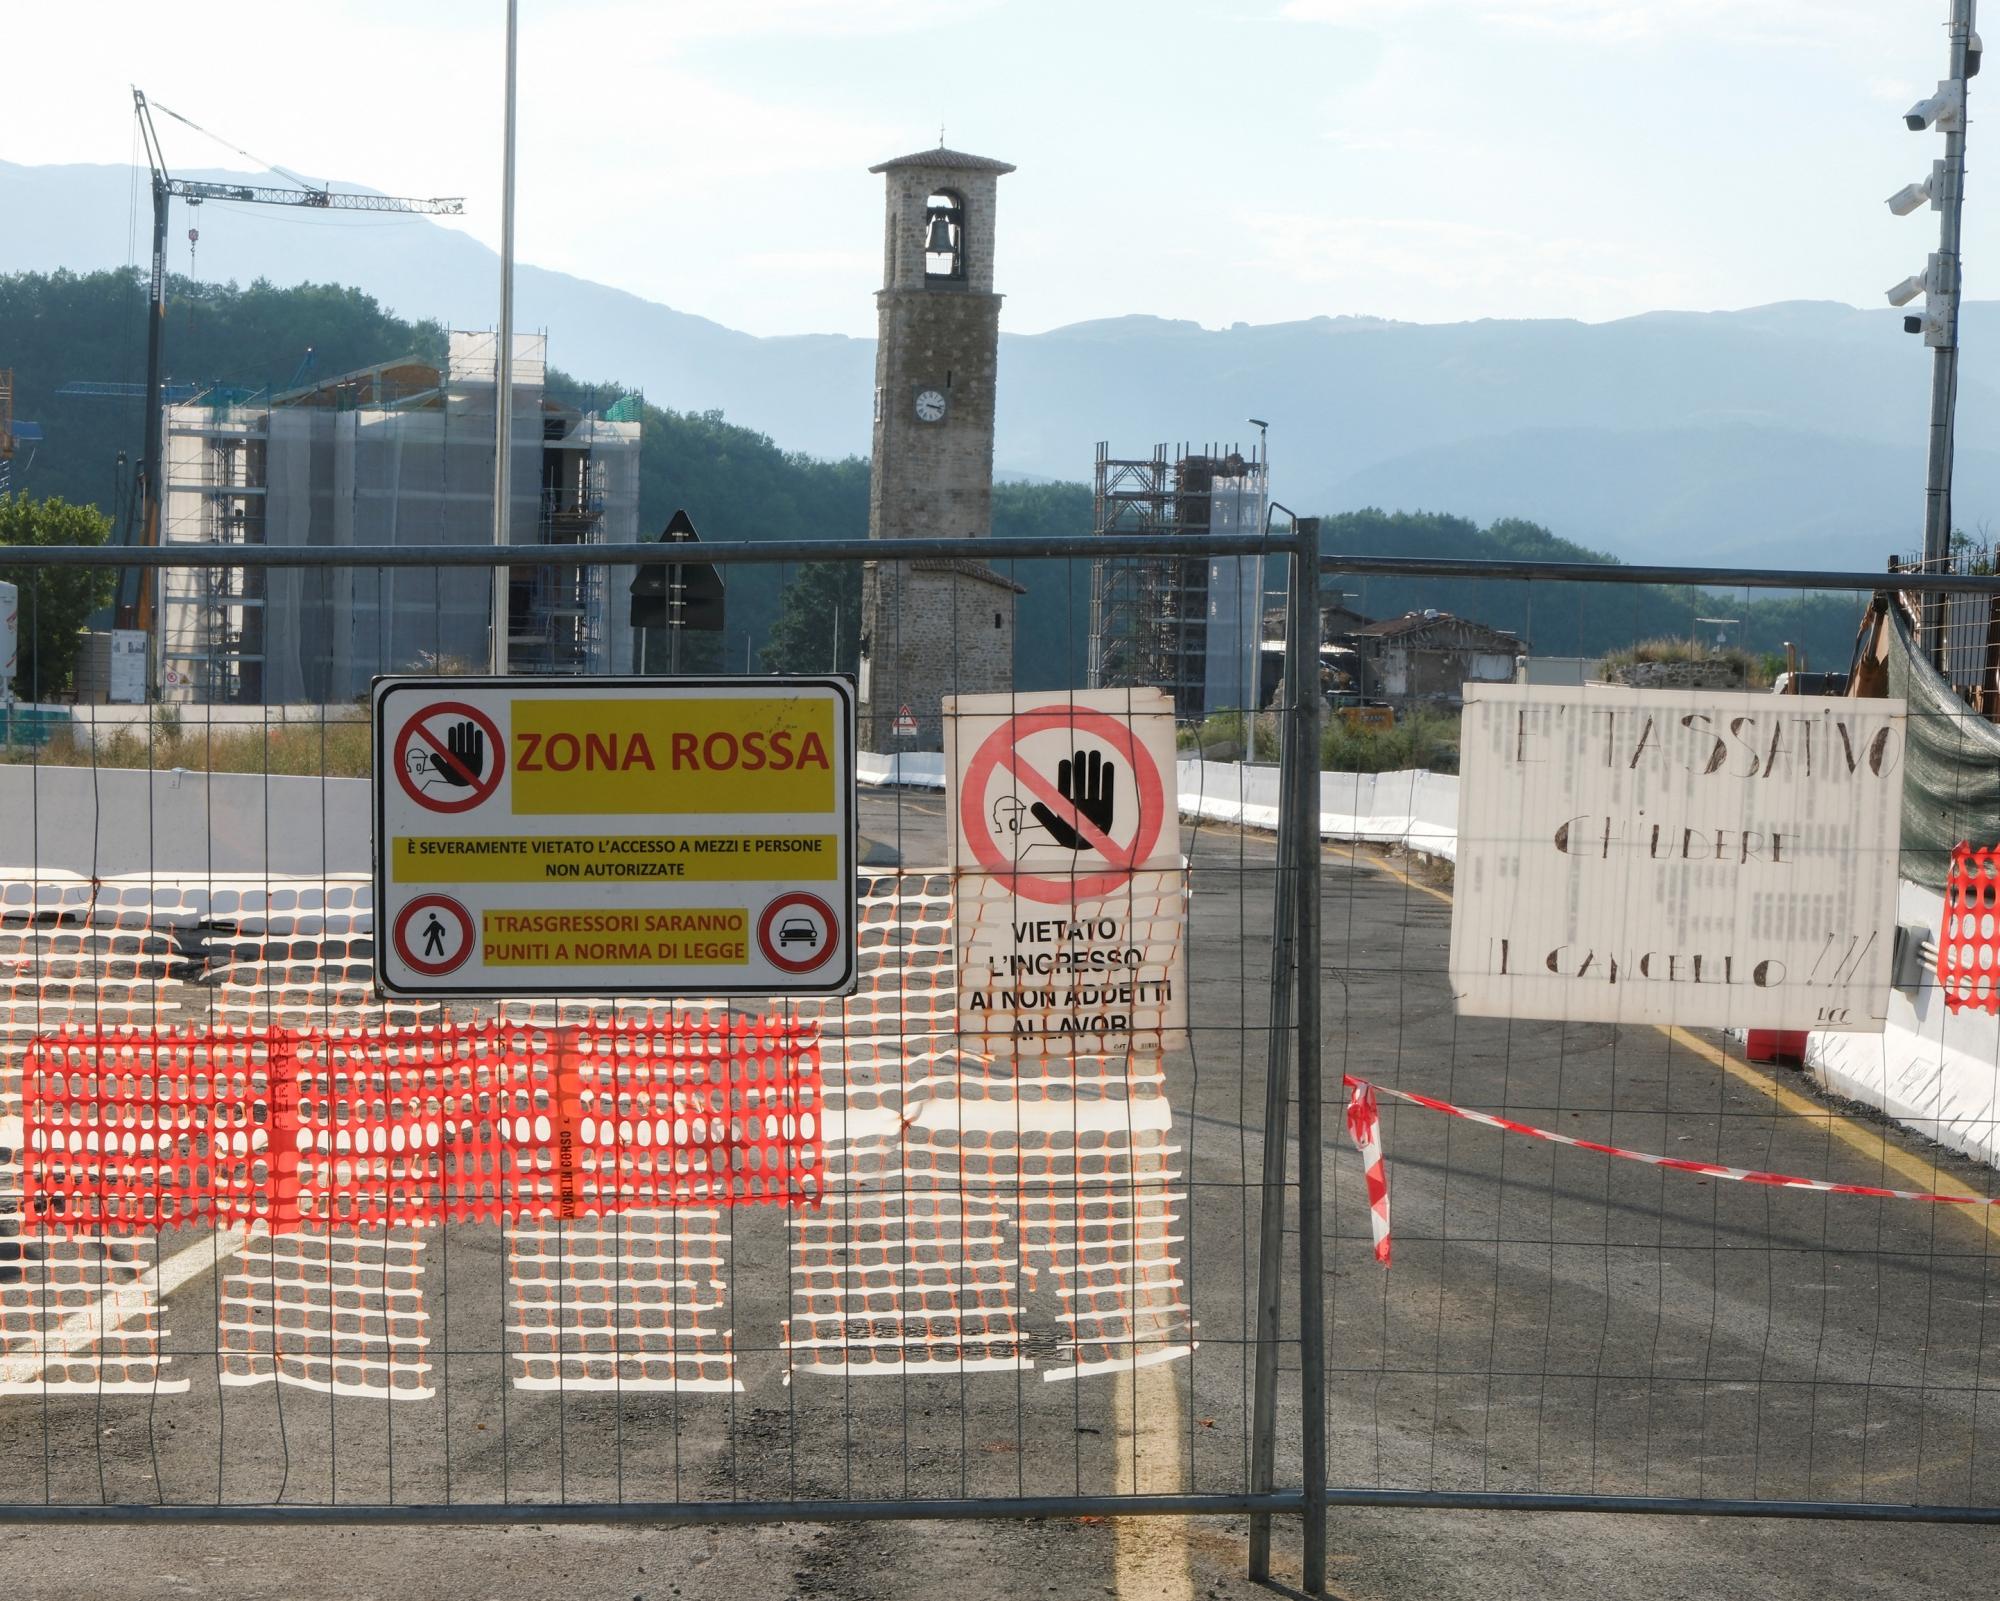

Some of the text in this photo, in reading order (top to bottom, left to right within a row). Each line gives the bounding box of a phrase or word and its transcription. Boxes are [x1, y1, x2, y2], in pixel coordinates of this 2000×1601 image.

[516, 731, 830, 772] ZONA ROSSA
[407, 838, 822, 855] È SEVERAMENTE VIETATO L'ACCESSO A MEZZI E PERSONE
[545, 863, 685, 877] NON AUTORIZZATE
[483, 914, 743, 933] I TRASGRESSORI SARANNO
[1011, 917, 1117, 943] VIETATO
[484, 943, 745, 961] PUNITI A NORMA DI LEGGE
[988, 948, 1143, 977] L'INGRESSO
[1546, 945, 1787, 988] CANCELLO
[1002, 986, 1057, 1010] NON
[1064, 980, 1172, 1007] ADDETTI
[560, 1130, 572, 1168] CORSO
